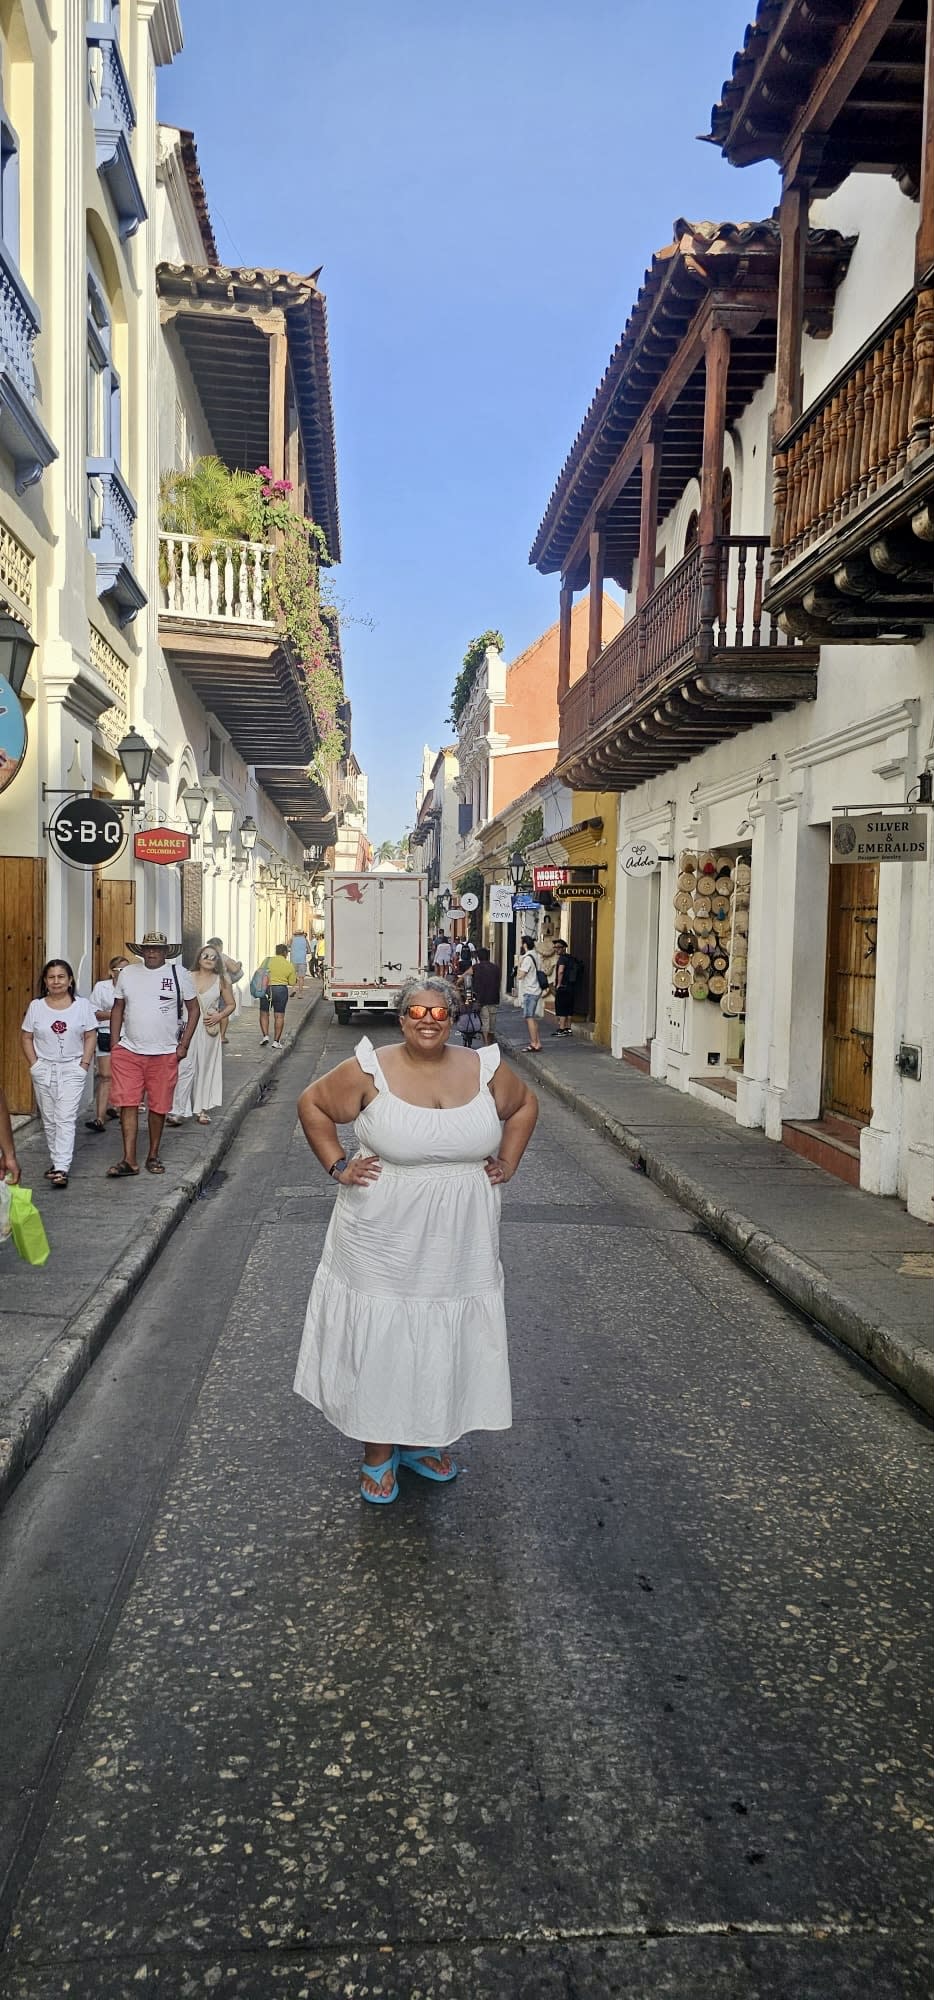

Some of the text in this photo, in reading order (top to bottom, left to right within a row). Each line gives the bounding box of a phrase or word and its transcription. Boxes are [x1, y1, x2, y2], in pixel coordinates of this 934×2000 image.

[56, 819, 120, 844] S-B-Q
[867, 822, 909, 832] SILVER
[886, 833, 893, 842] &
[137, 838, 186, 848] EL MARKET
[858, 843, 925, 853] EMERALDS
[625, 855, 655, 869] Adda
[536, 870, 564, 880] MONEY
